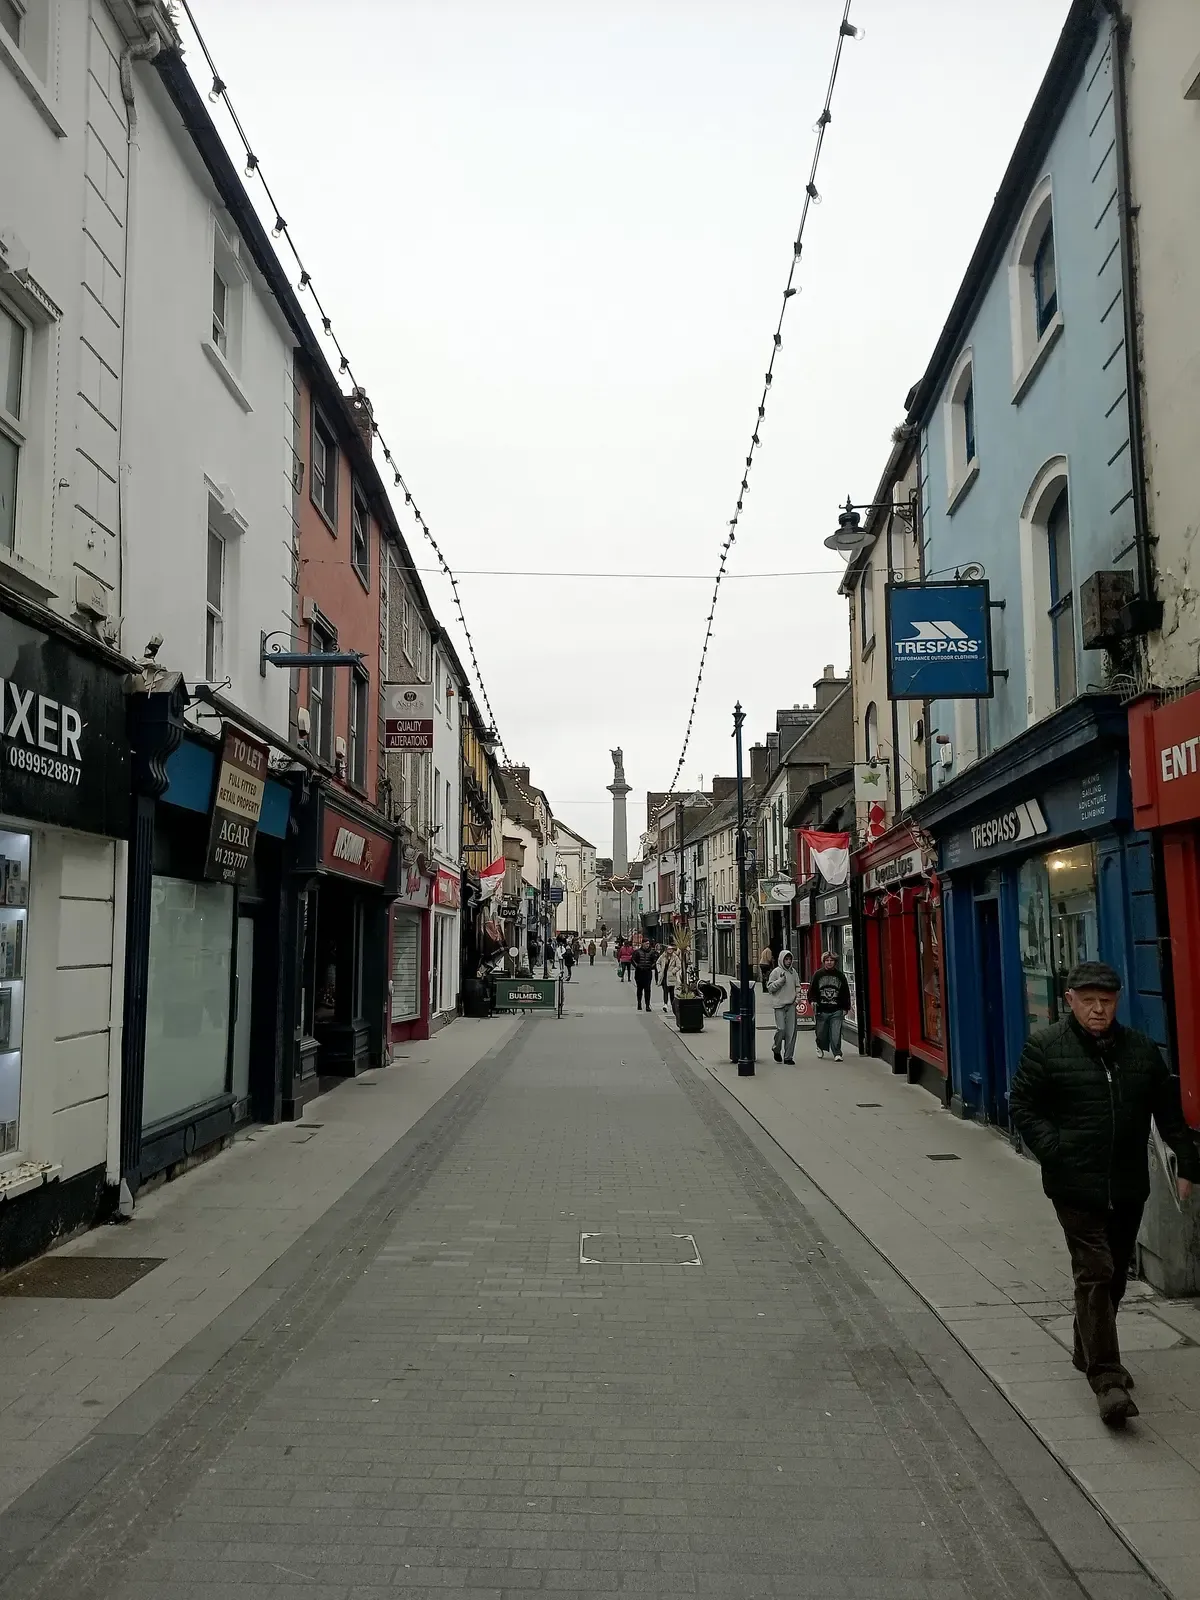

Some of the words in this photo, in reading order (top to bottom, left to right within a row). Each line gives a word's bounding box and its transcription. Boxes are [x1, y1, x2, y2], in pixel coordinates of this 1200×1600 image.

[895, 640, 978, 654] TRESPASS
[396, 720, 422, 732] QUALITY
[390, 735, 428, 746] ALTERATIONS
[234, 737, 246, 762] TO
[246, 745, 263, 771] LET
[1161, 734, 1200, 782] ENT
[10, 746, 81, 786] 0899528877
[1082, 773, 1100, 787] HIKING
[1081, 784, 1102, 798] SAILING
[219, 787, 236, 805] RETAIL
[236, 794, 261, 815] PROPERTY
[1078, 794, 1107, 810] ADVENTURE
[1081, 806, 1105, 821] CLIMBING
[218, 819, 250, 848] AGAR
[971, 811, 1016, 850] TRESPASS
[214, 847, 223, 863] 01
[502, 908, 516, 916] DV8
[717, 904, 737, 913] DNG
[508, 992, 543, 1000] BULMERS
